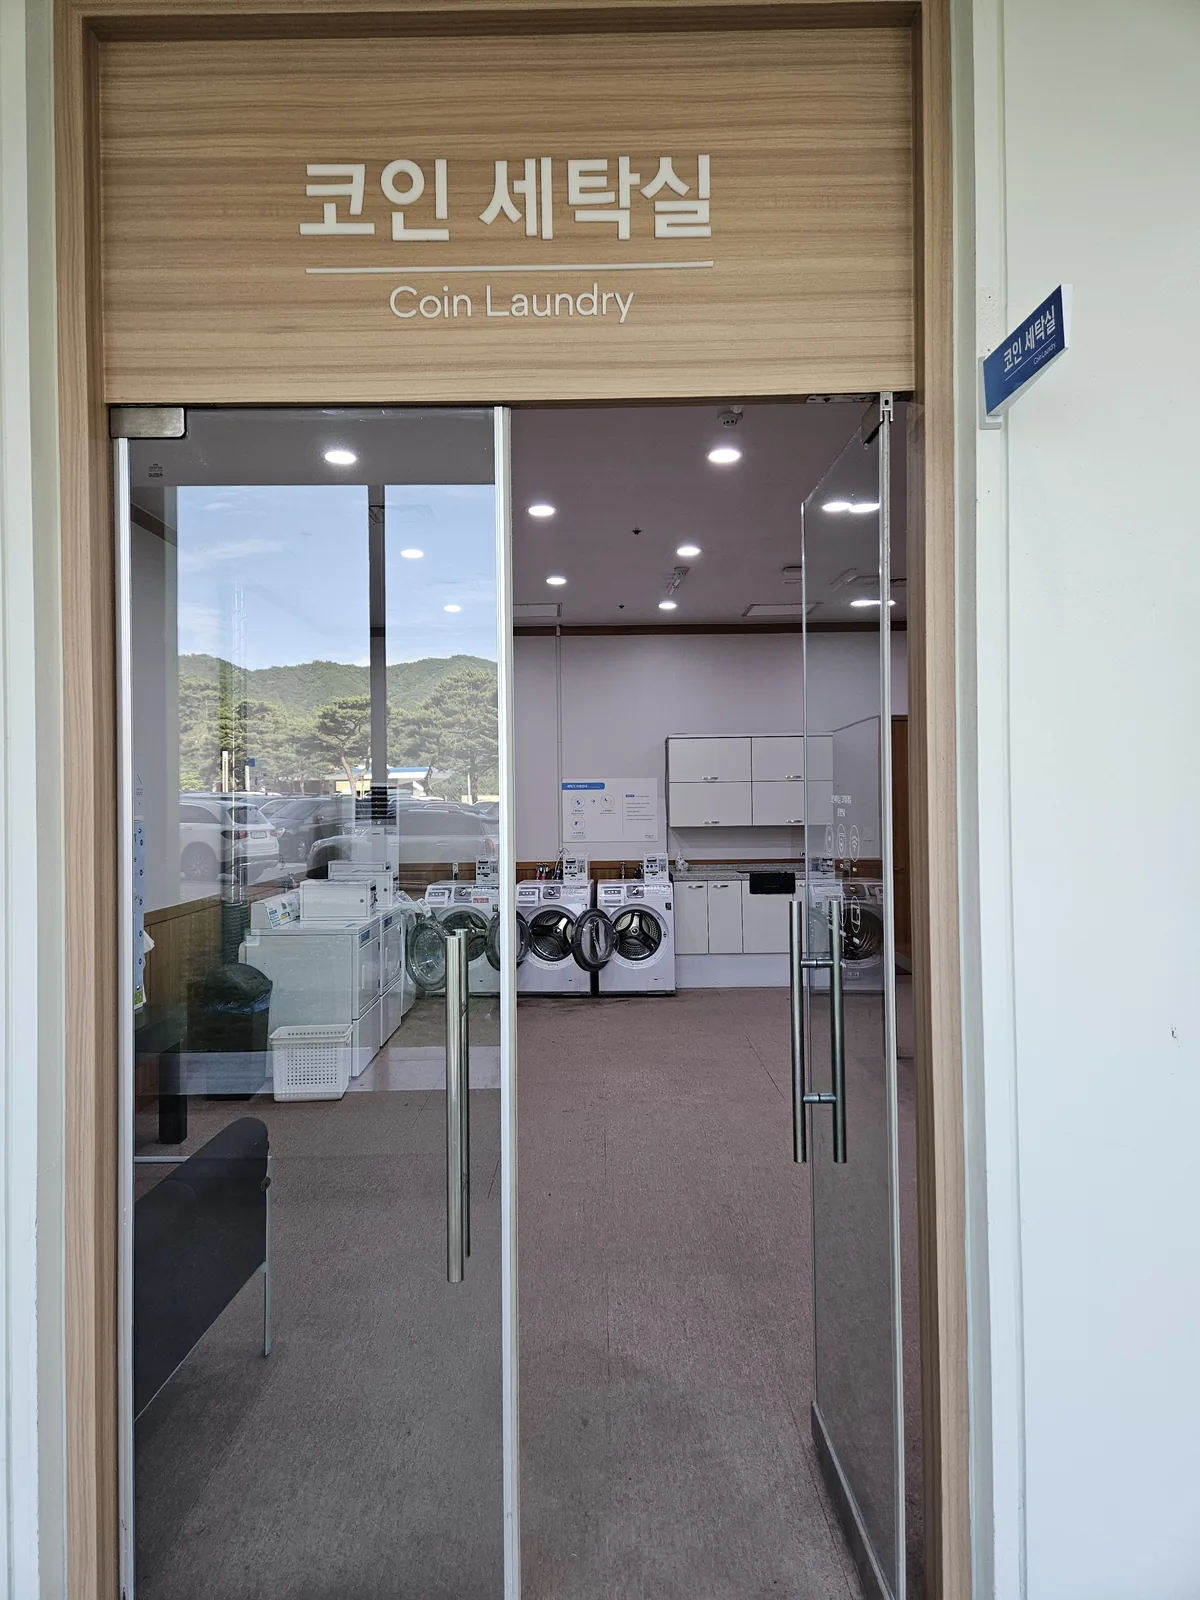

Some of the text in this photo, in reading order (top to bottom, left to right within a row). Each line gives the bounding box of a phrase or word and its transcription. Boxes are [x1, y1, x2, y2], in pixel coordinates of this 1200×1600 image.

[299, 153, 712, 242] 코인 세탁실
[389, 282, 635, 324] Coin Laundry
[1003, 304, 1056, 373] 코인 세탁실
